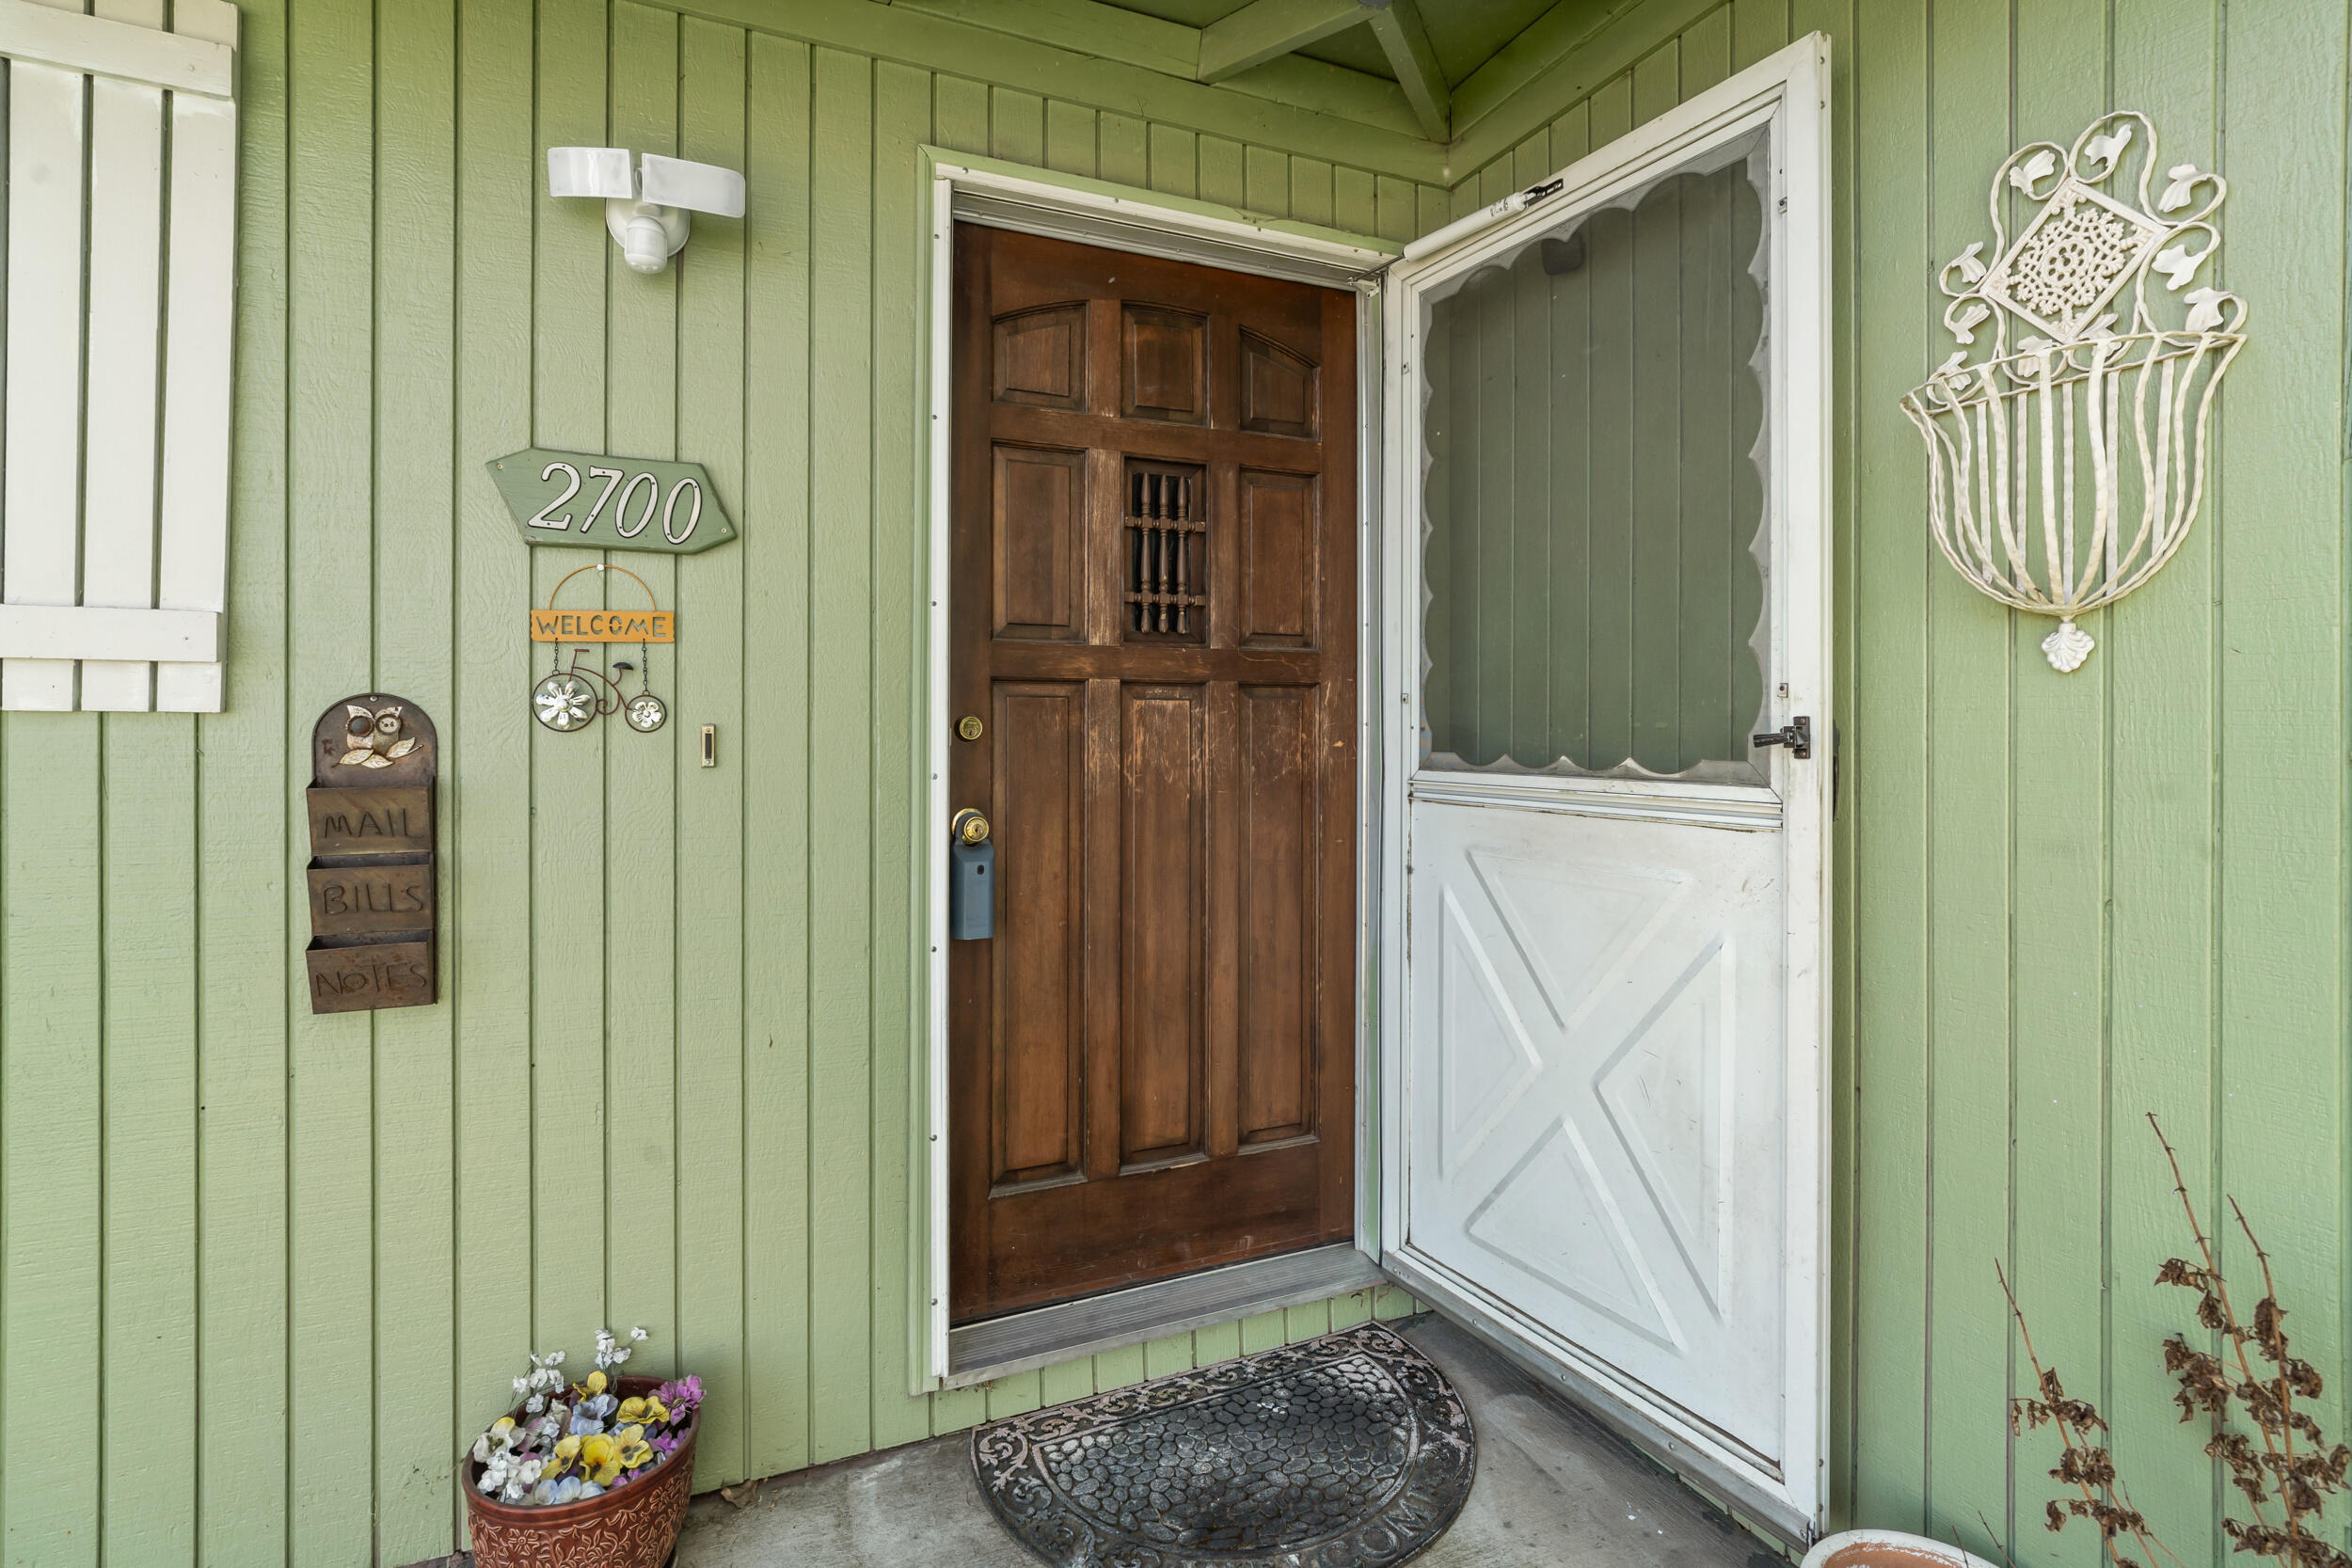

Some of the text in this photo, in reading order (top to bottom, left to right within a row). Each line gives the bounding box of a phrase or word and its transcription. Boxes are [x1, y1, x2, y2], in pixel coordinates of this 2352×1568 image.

[527, 461, 702, 545] 2700
[535, 614, 666, 637] WELCOME
[324, 808, 423, 839] MAIL
[324, 883, 423, 914] BILLS
[315, 962, 427, 997] NOTES
